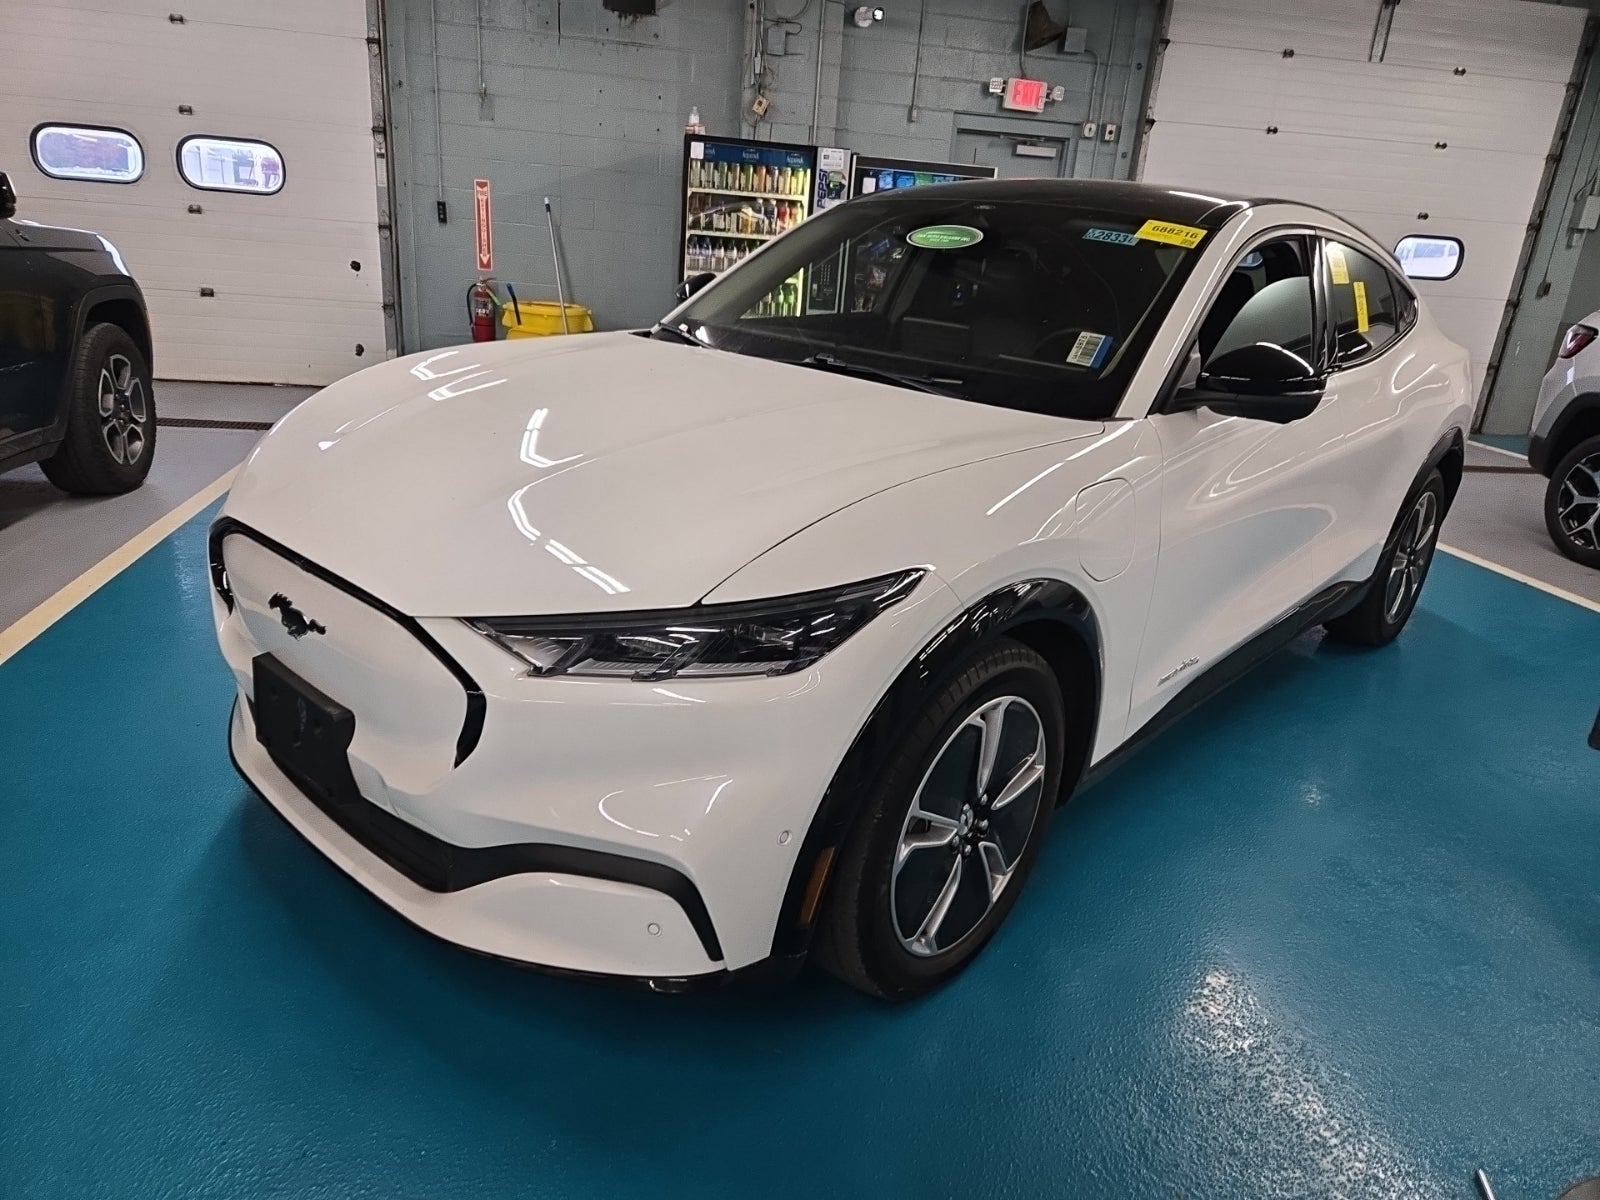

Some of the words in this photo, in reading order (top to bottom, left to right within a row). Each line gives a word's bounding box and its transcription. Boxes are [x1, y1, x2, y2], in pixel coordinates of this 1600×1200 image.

[1014, 83, 1043, 107] EXIT
[816, 168, 829, 209] PEPSI
[1151, 224, 1199, 240] 688216
